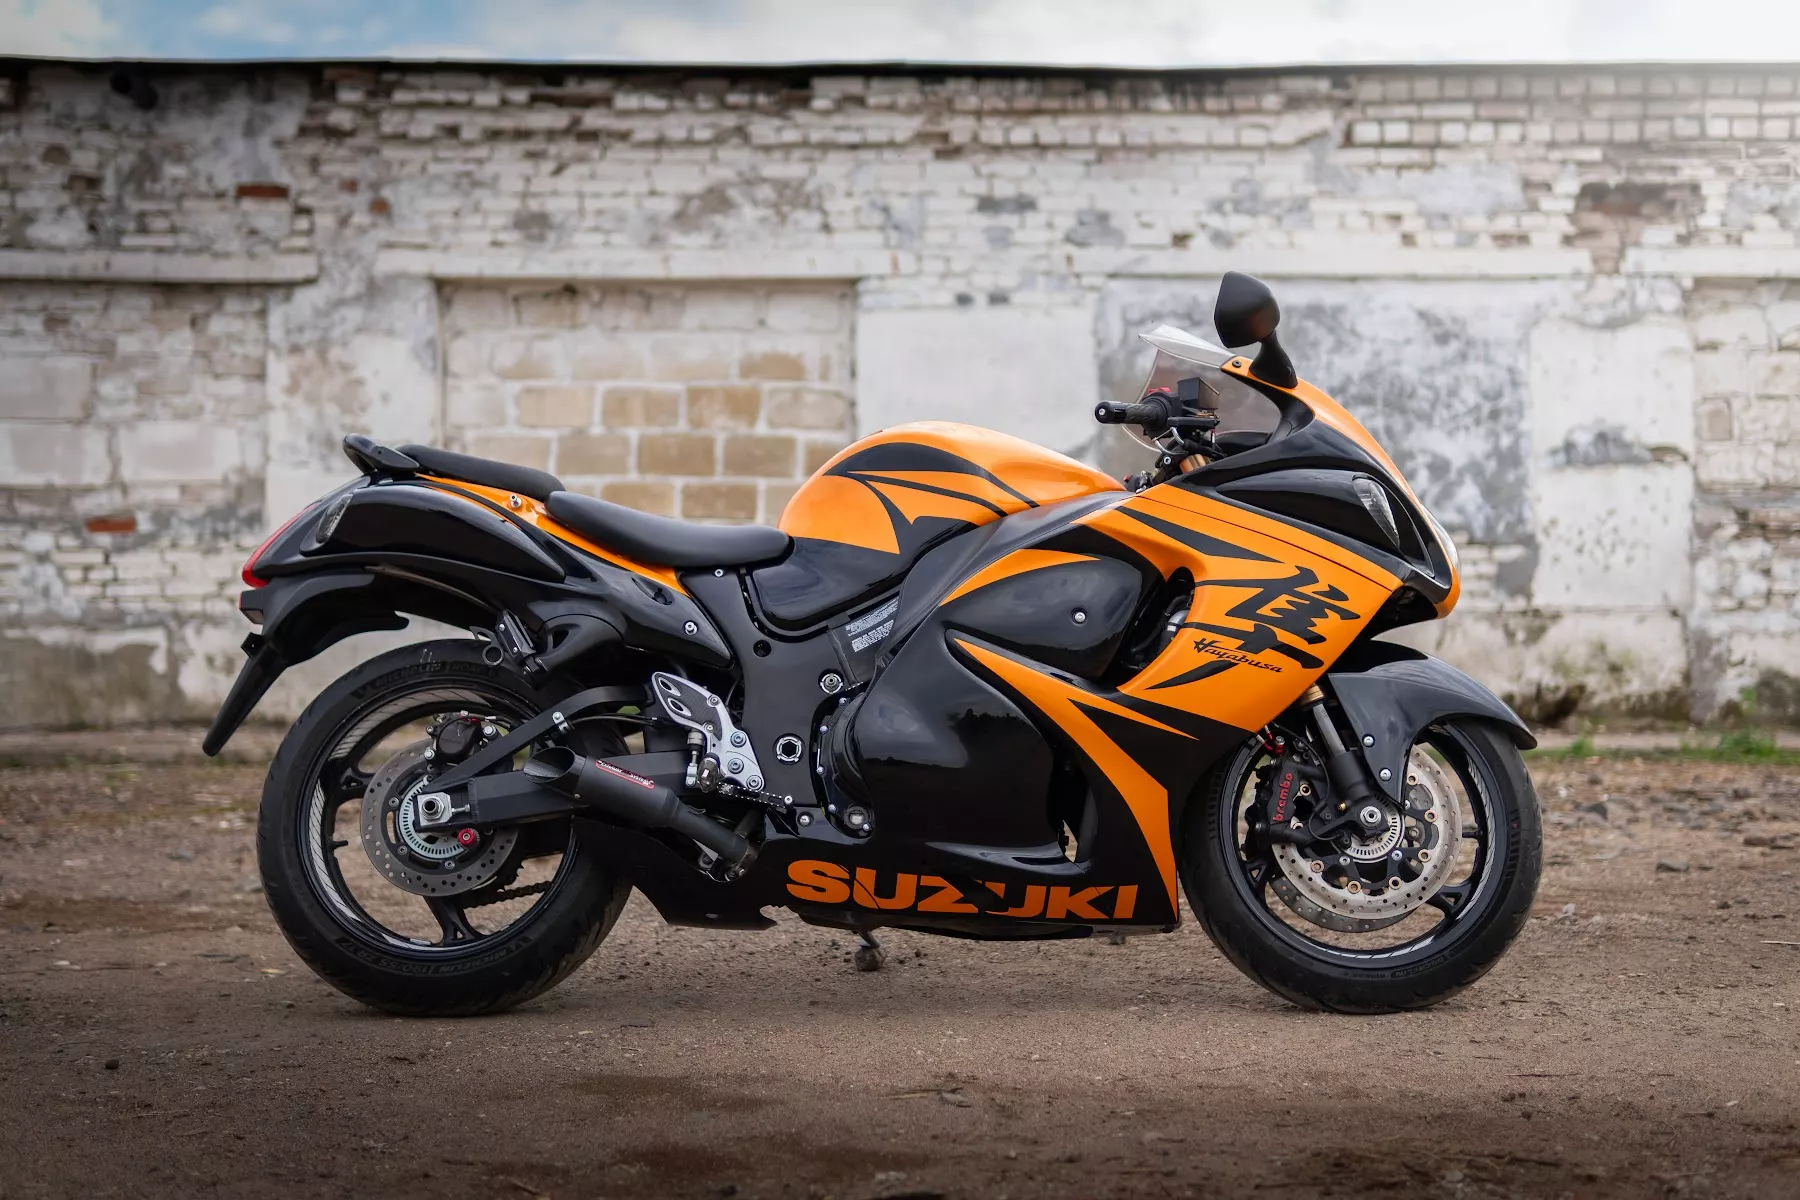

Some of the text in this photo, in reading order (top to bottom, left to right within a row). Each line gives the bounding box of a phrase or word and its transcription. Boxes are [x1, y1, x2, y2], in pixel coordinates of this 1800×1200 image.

[1193, 637, 1283, 673] Hayabusa
[1272, 772, 1293, 822] brembo
[786, 859, 1139, 919] SUZUKI
